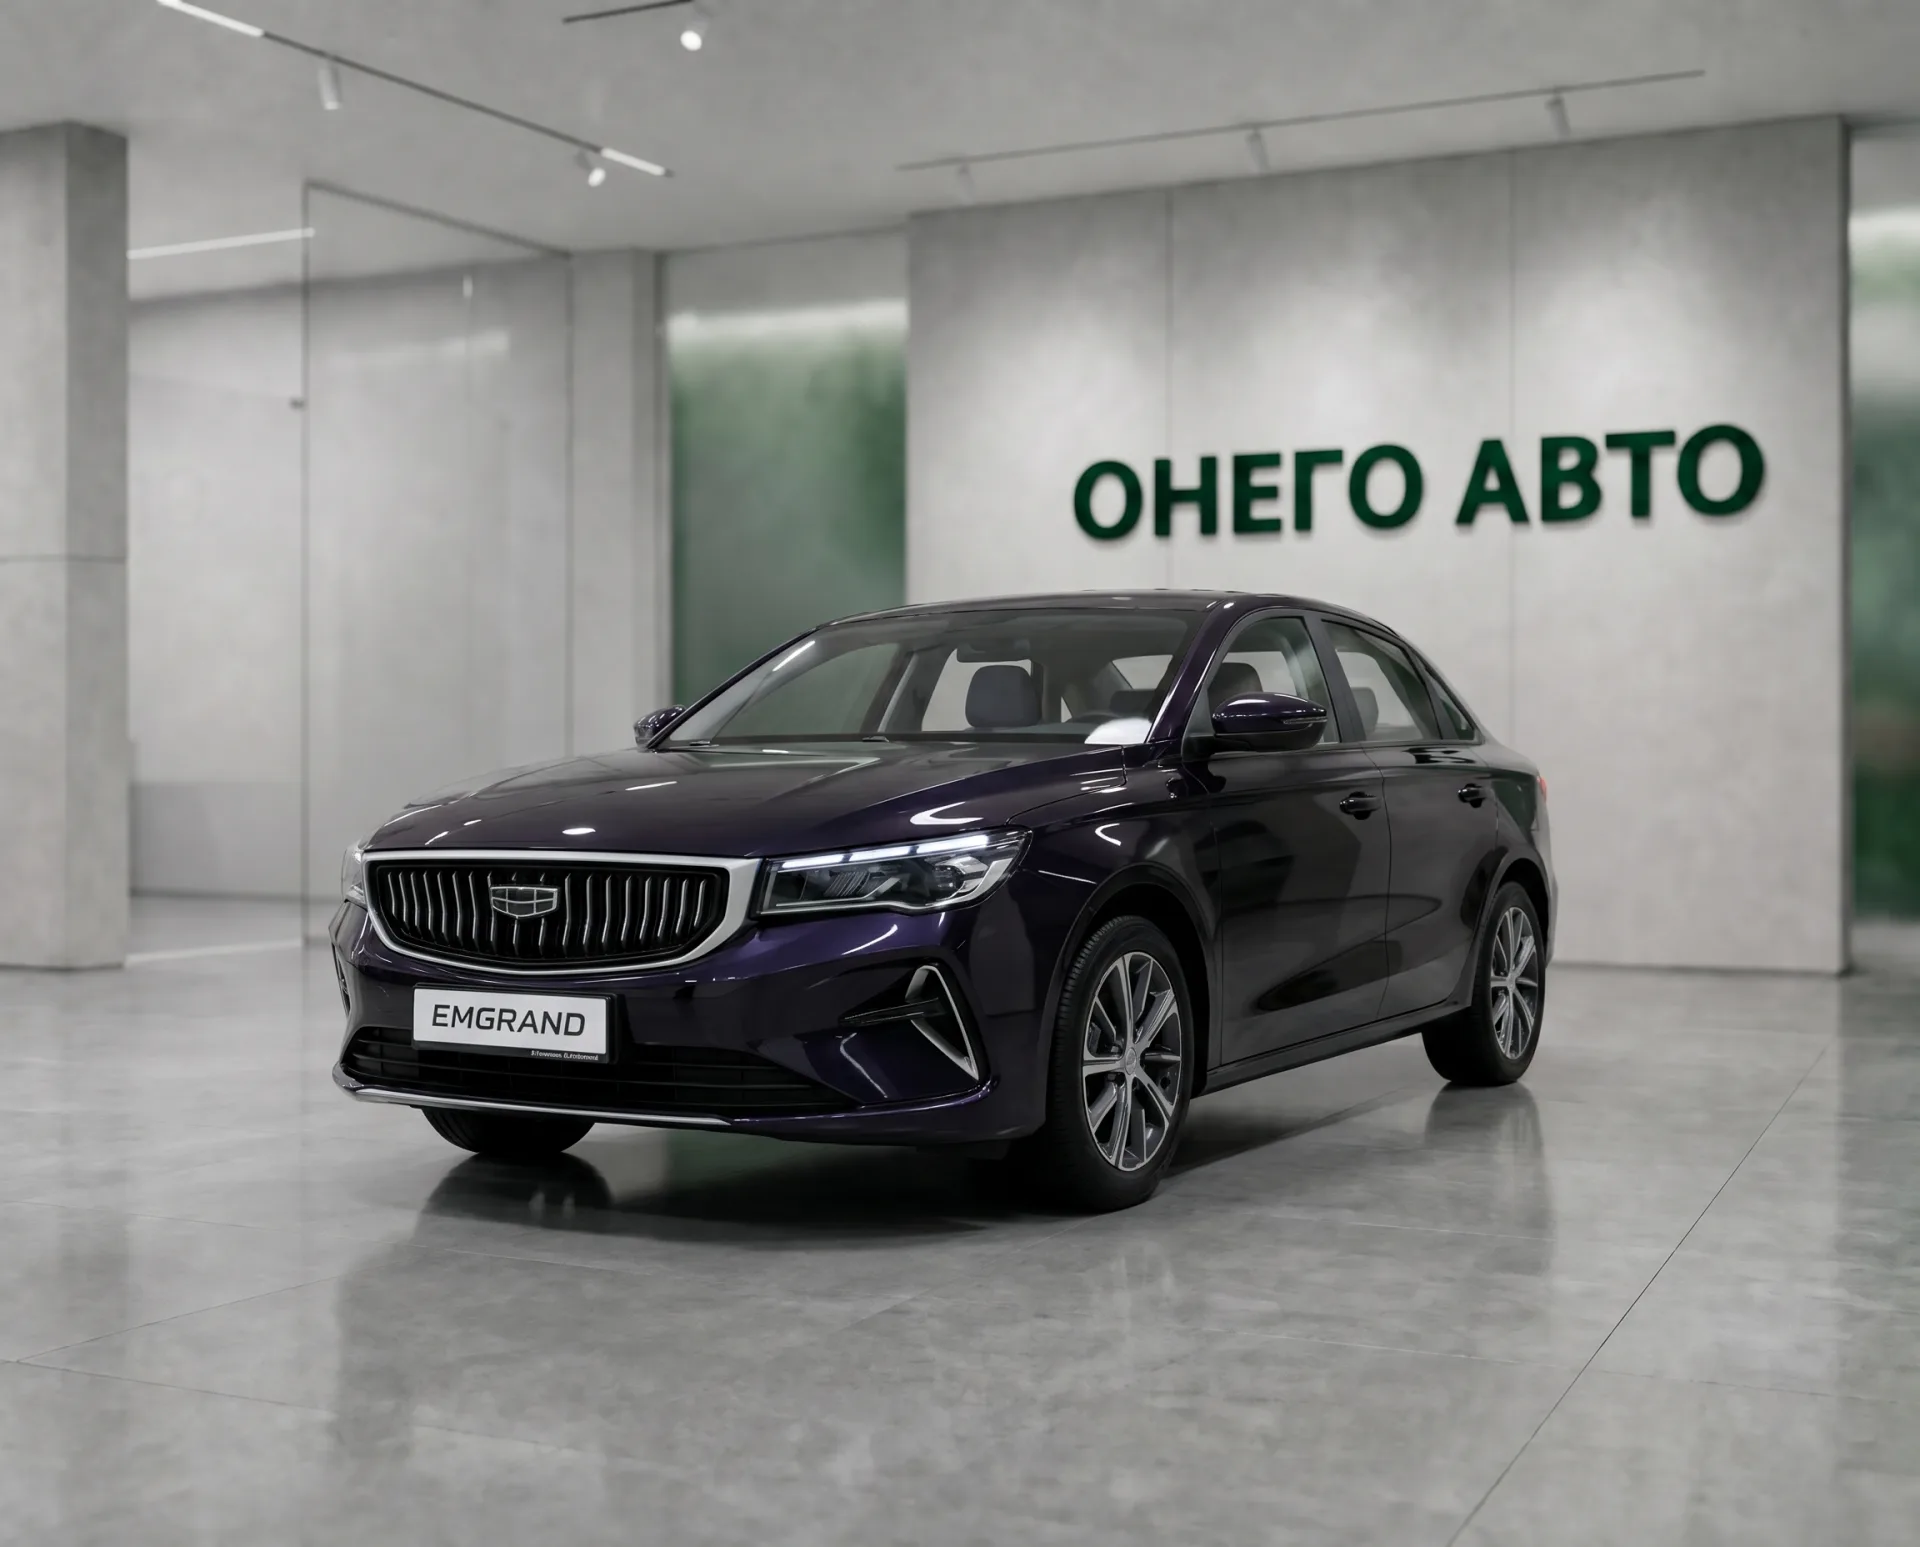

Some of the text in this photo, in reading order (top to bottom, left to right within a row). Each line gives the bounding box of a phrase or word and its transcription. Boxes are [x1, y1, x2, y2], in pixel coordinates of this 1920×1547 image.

[1074, 424, 1765, 540] ОНЕГО АВТО
[432, 1004, 586, 1036] EMGRAND
